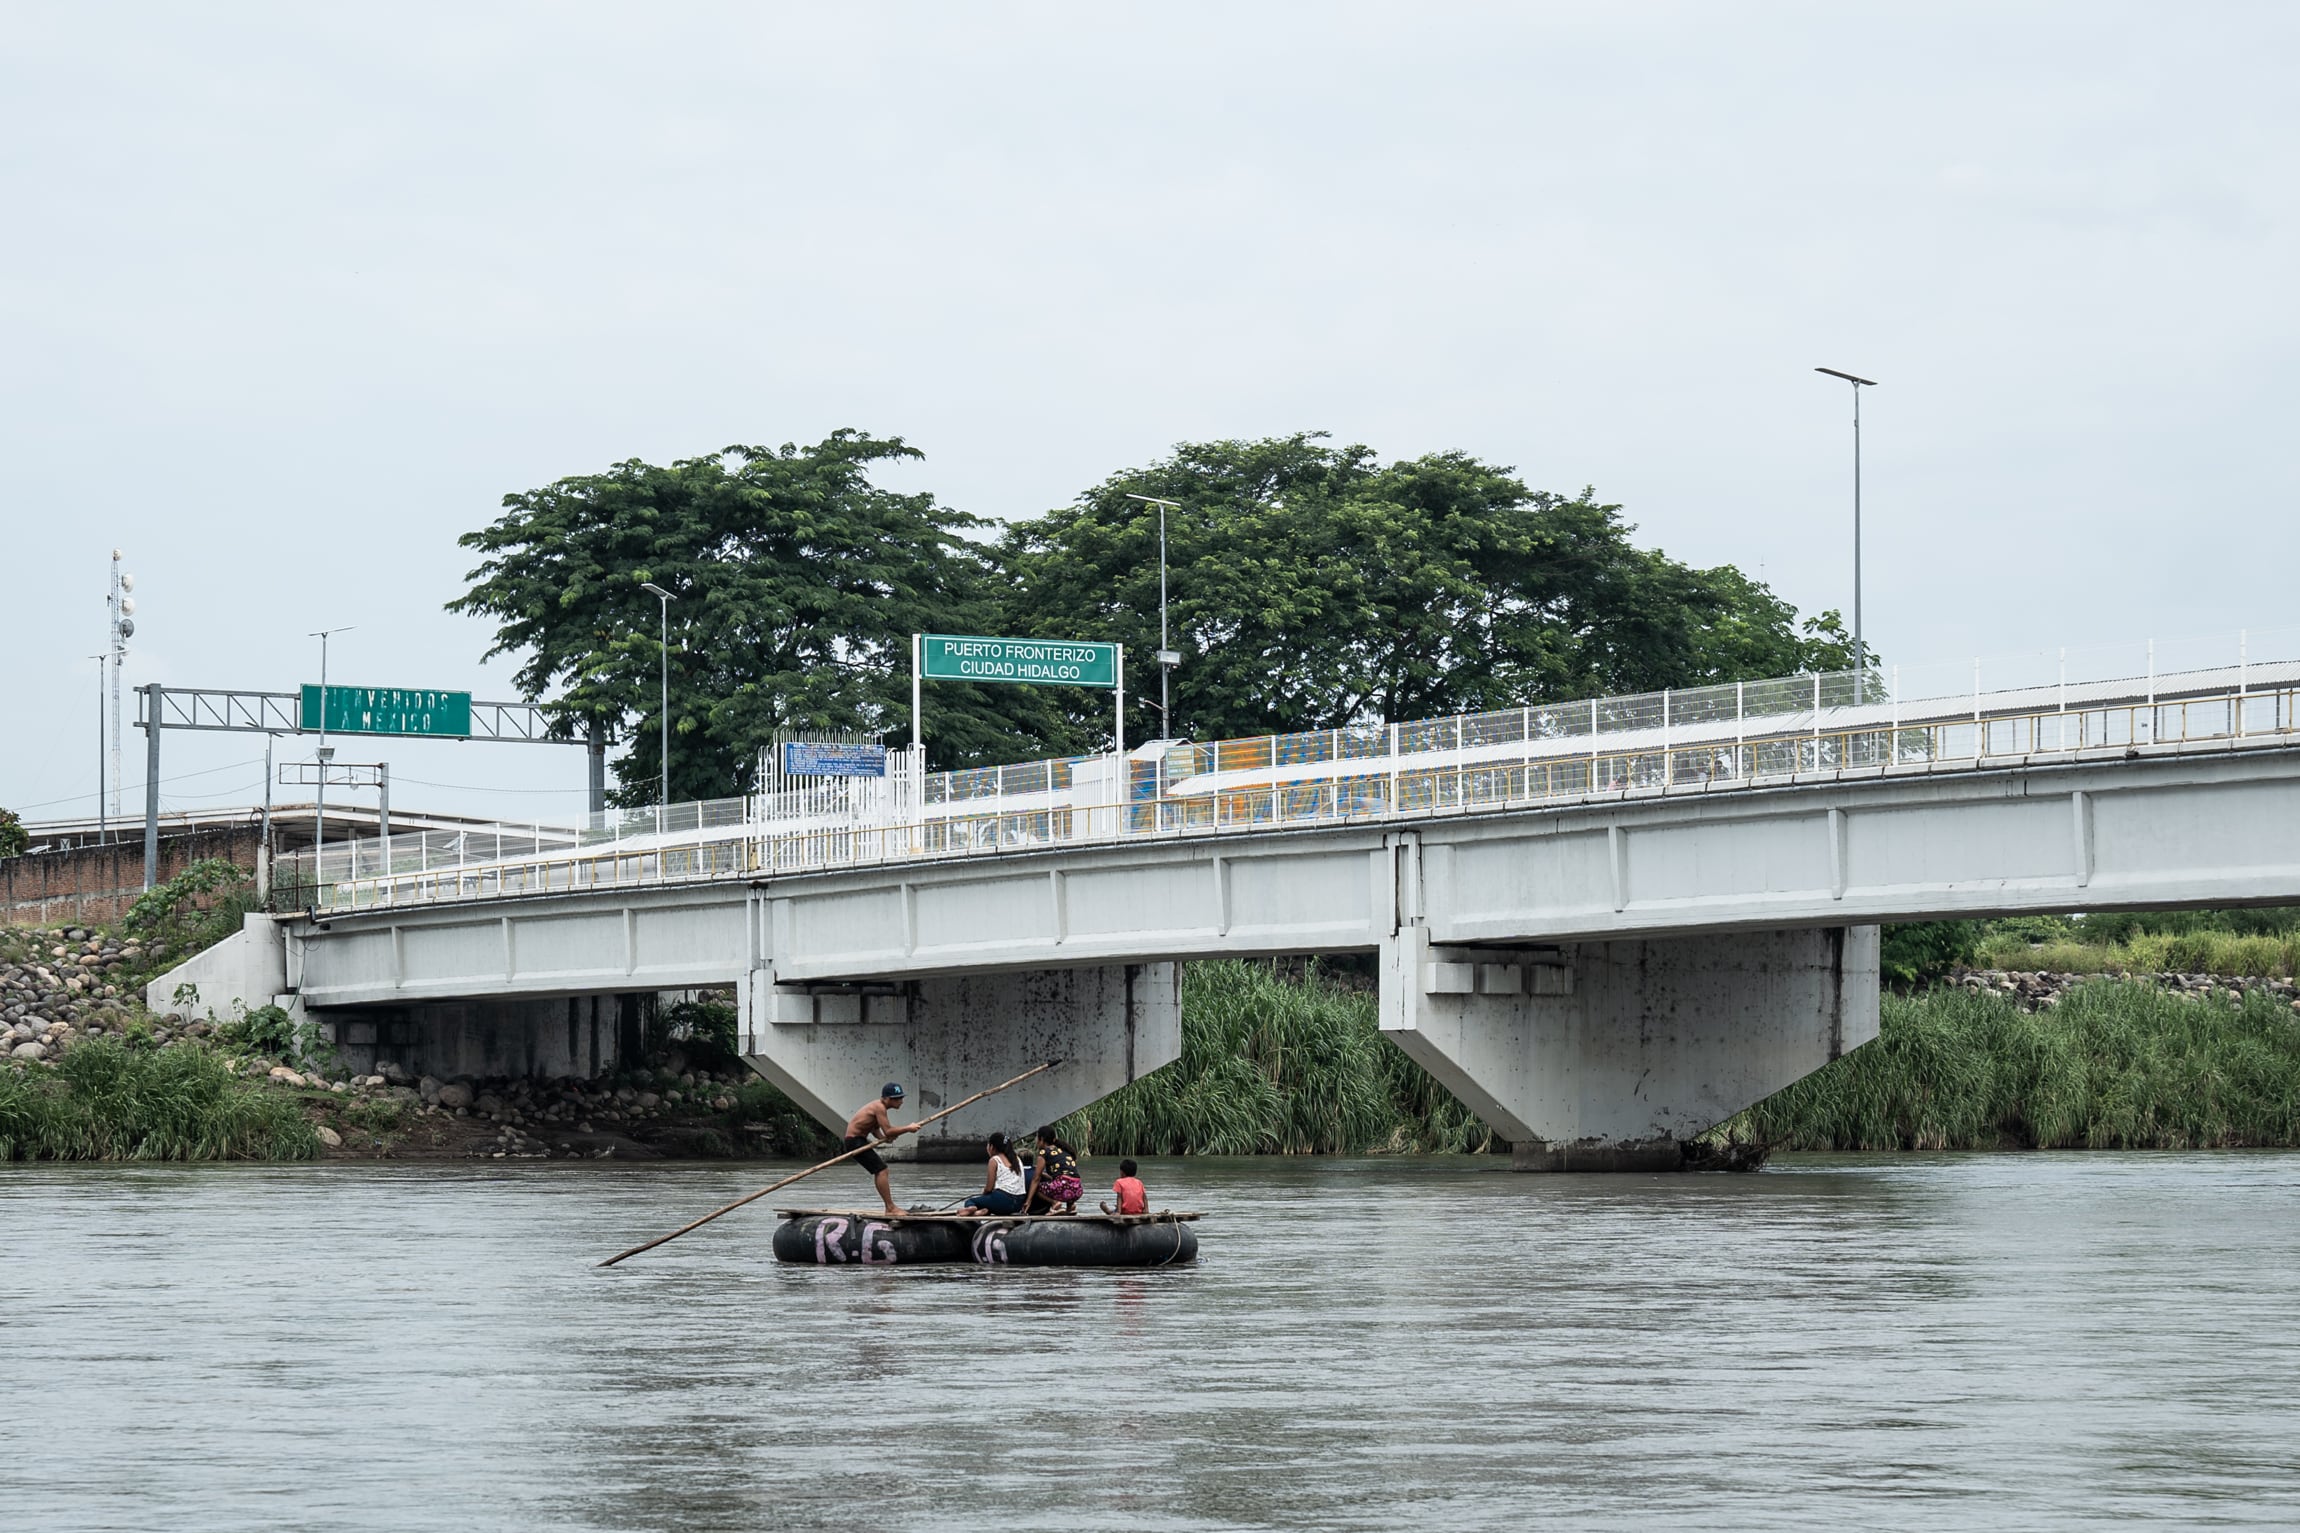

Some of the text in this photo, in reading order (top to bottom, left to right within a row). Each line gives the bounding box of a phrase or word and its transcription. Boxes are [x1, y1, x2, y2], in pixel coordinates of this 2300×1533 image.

[944, 642, 1096, 663] PUERTO FRONTERIZO
[960, 660, 1080, 680] CIUDAD HIDALGO
[323, 688, 449, 712] IENVENIDOS
[341, 711, 350, 729] A
